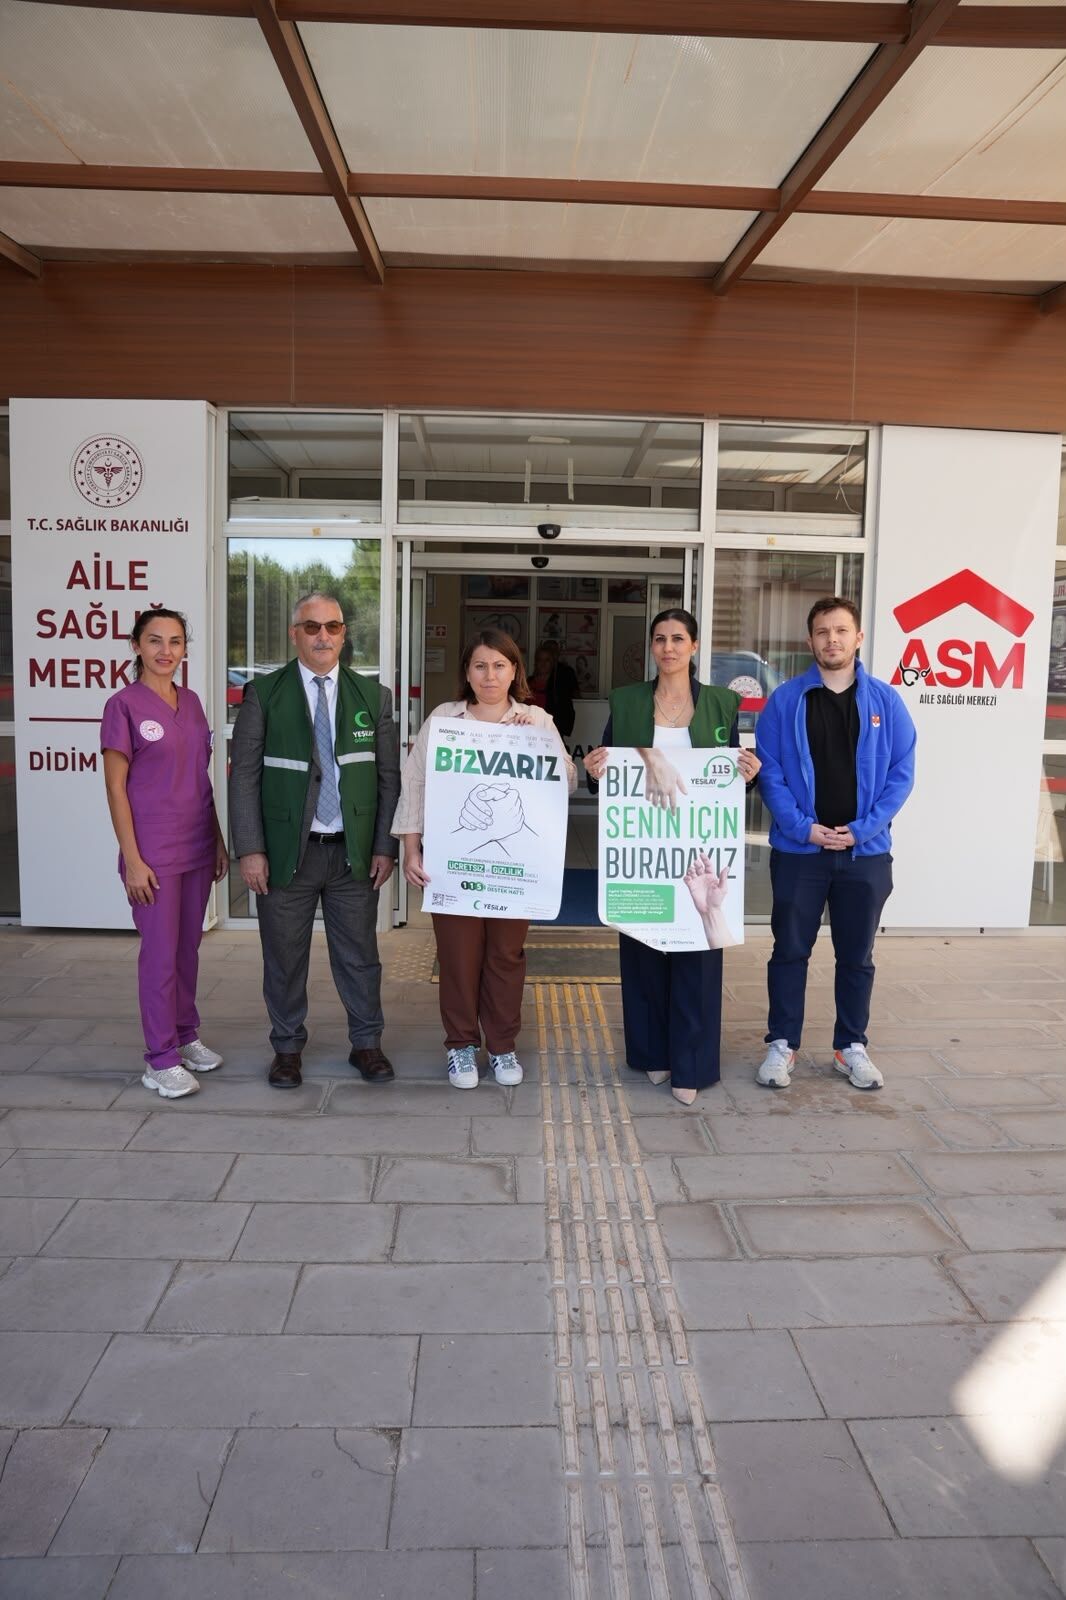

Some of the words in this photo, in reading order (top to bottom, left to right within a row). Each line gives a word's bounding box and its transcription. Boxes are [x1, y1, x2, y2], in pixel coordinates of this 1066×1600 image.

[27, 517, 53, 532] T.C.
[56, 516, 107, 532] SAĞLIK
[110, 517, 189, 533] BAKANLIĞI
[66, 552, 149, 590] AİLE
[29, 653, 188, 689] MERKİ
[889, 638, 1026, 690] ASM
[919, 693, 935, 705] AİLE
[936, 693, 965, 706] SAĞLIĞI
[966, 694, 997, 707] MERKEZİ
[30, 746, 97, 772] DİDİM
[711, 764, 731, 774] 115
[606, 759, 644, 797] BİZ
[690, 778, 717, 786] YEŞİLAY
[690, 801, 738, 844] İÇİN
[448, 861, 485, 873] ÜCRETSİZ
[492, 865, 524, 877] GİZLİLİK
[463, 881, 482, 890] 115
[483, 903, 509, 912] YEŞİLAY
